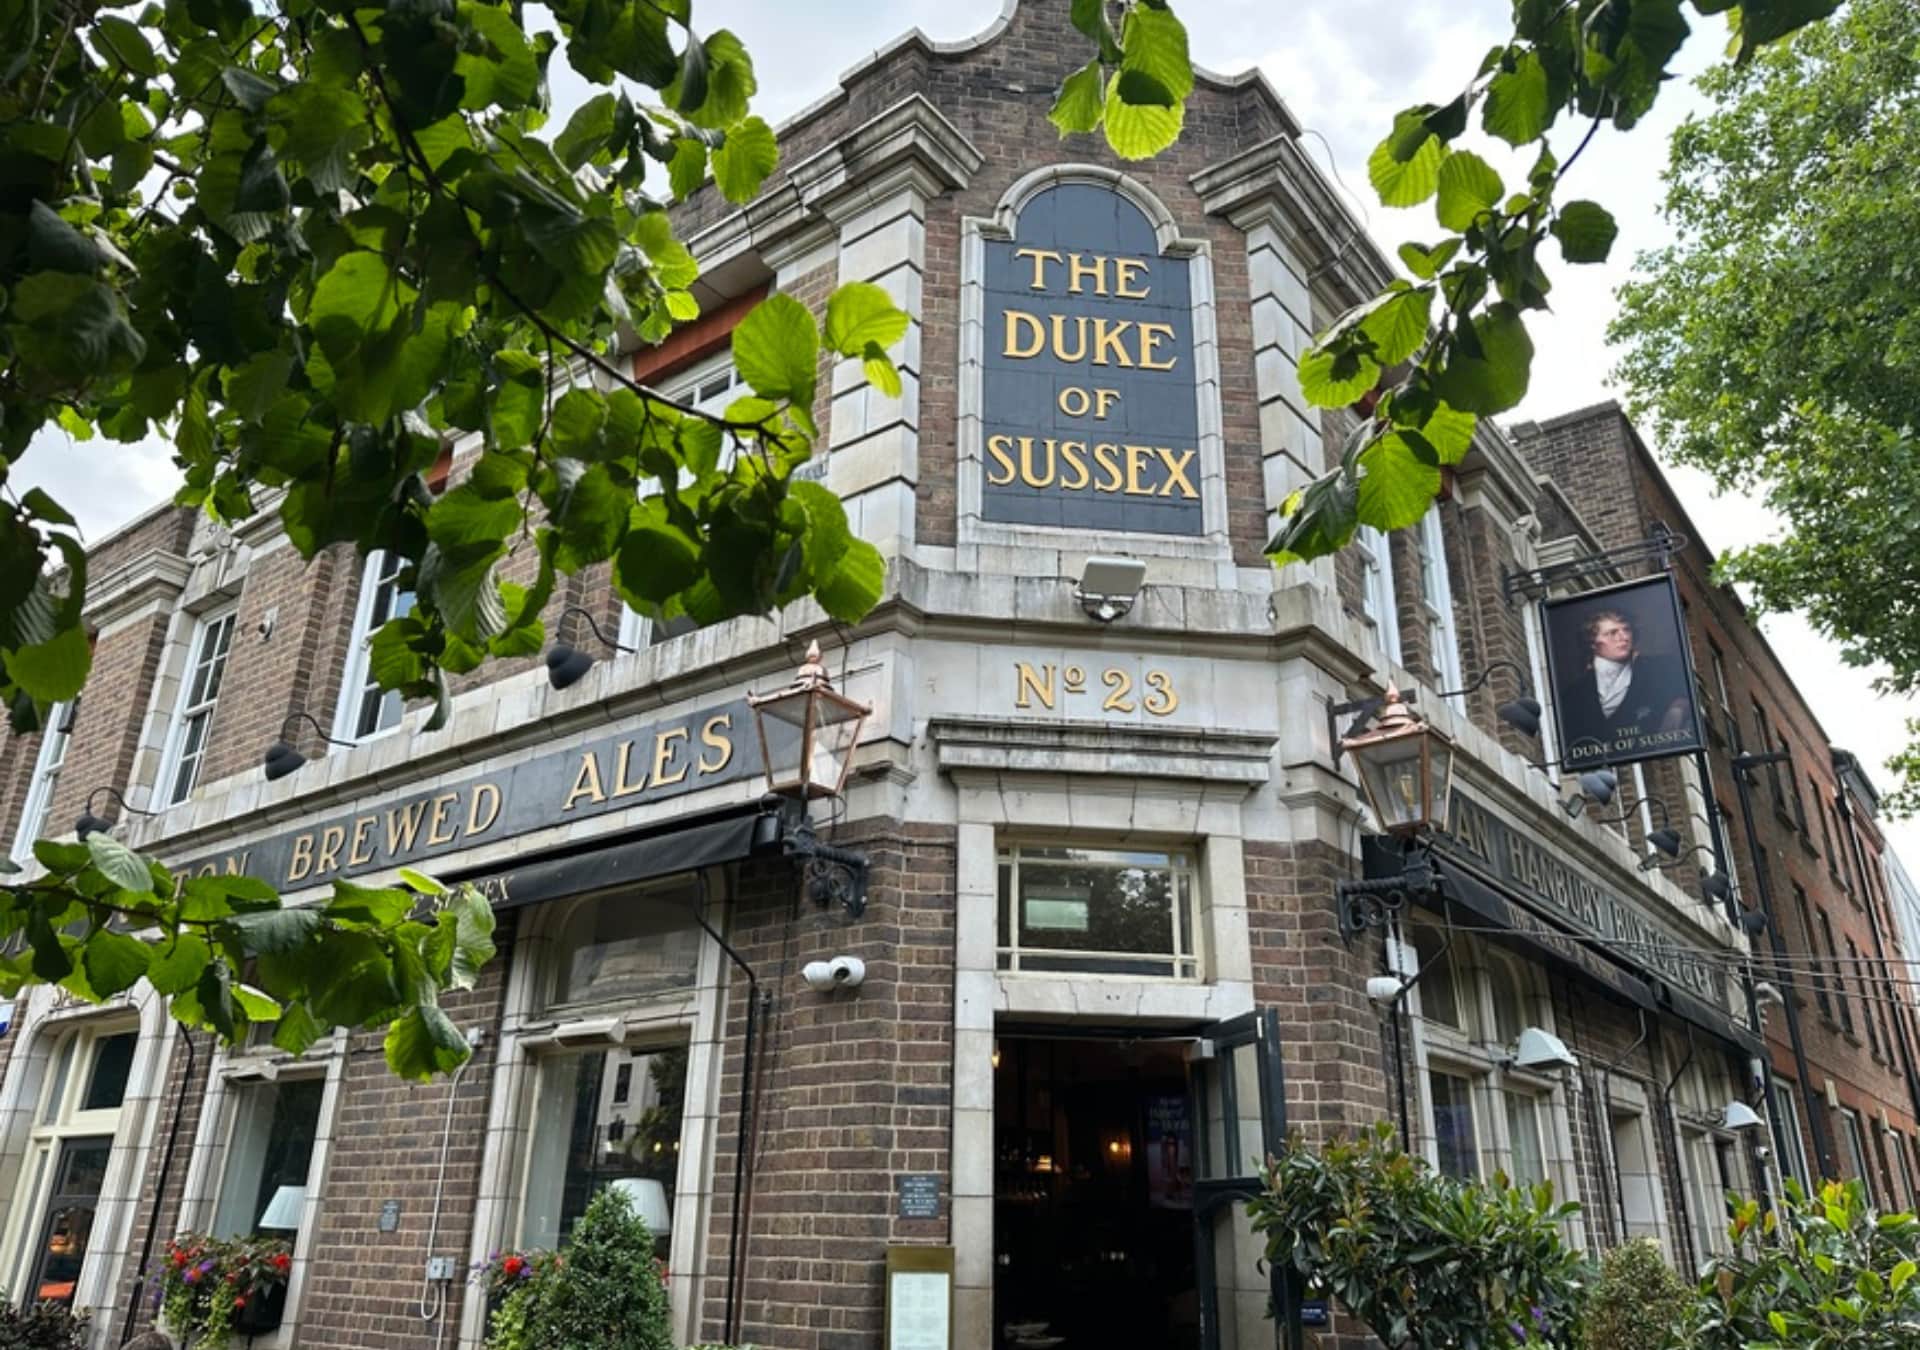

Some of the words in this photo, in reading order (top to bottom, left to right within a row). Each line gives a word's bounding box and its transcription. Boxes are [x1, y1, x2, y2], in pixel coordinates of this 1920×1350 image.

[1015, 248, 1152, 300] THE
[1002, 309, 1178, 372] DUKE
[1058, 386, 1122, 420] OF
[987, 434, 1200, 500] SUSSEX
[1101, 668, 1179, 717] 23
[1572, 740, 1614, 759] DUKE
[1615, 738, 1634, 752] OF
[1639, 727, 1693, 748] SUSSEX
[1616, 726, 1641, 737] THE
[286, 783, 502, 883] BREWED
[562, 712, 735, 811] ALES
[1505, 830, 1603, 934] HANBURY
